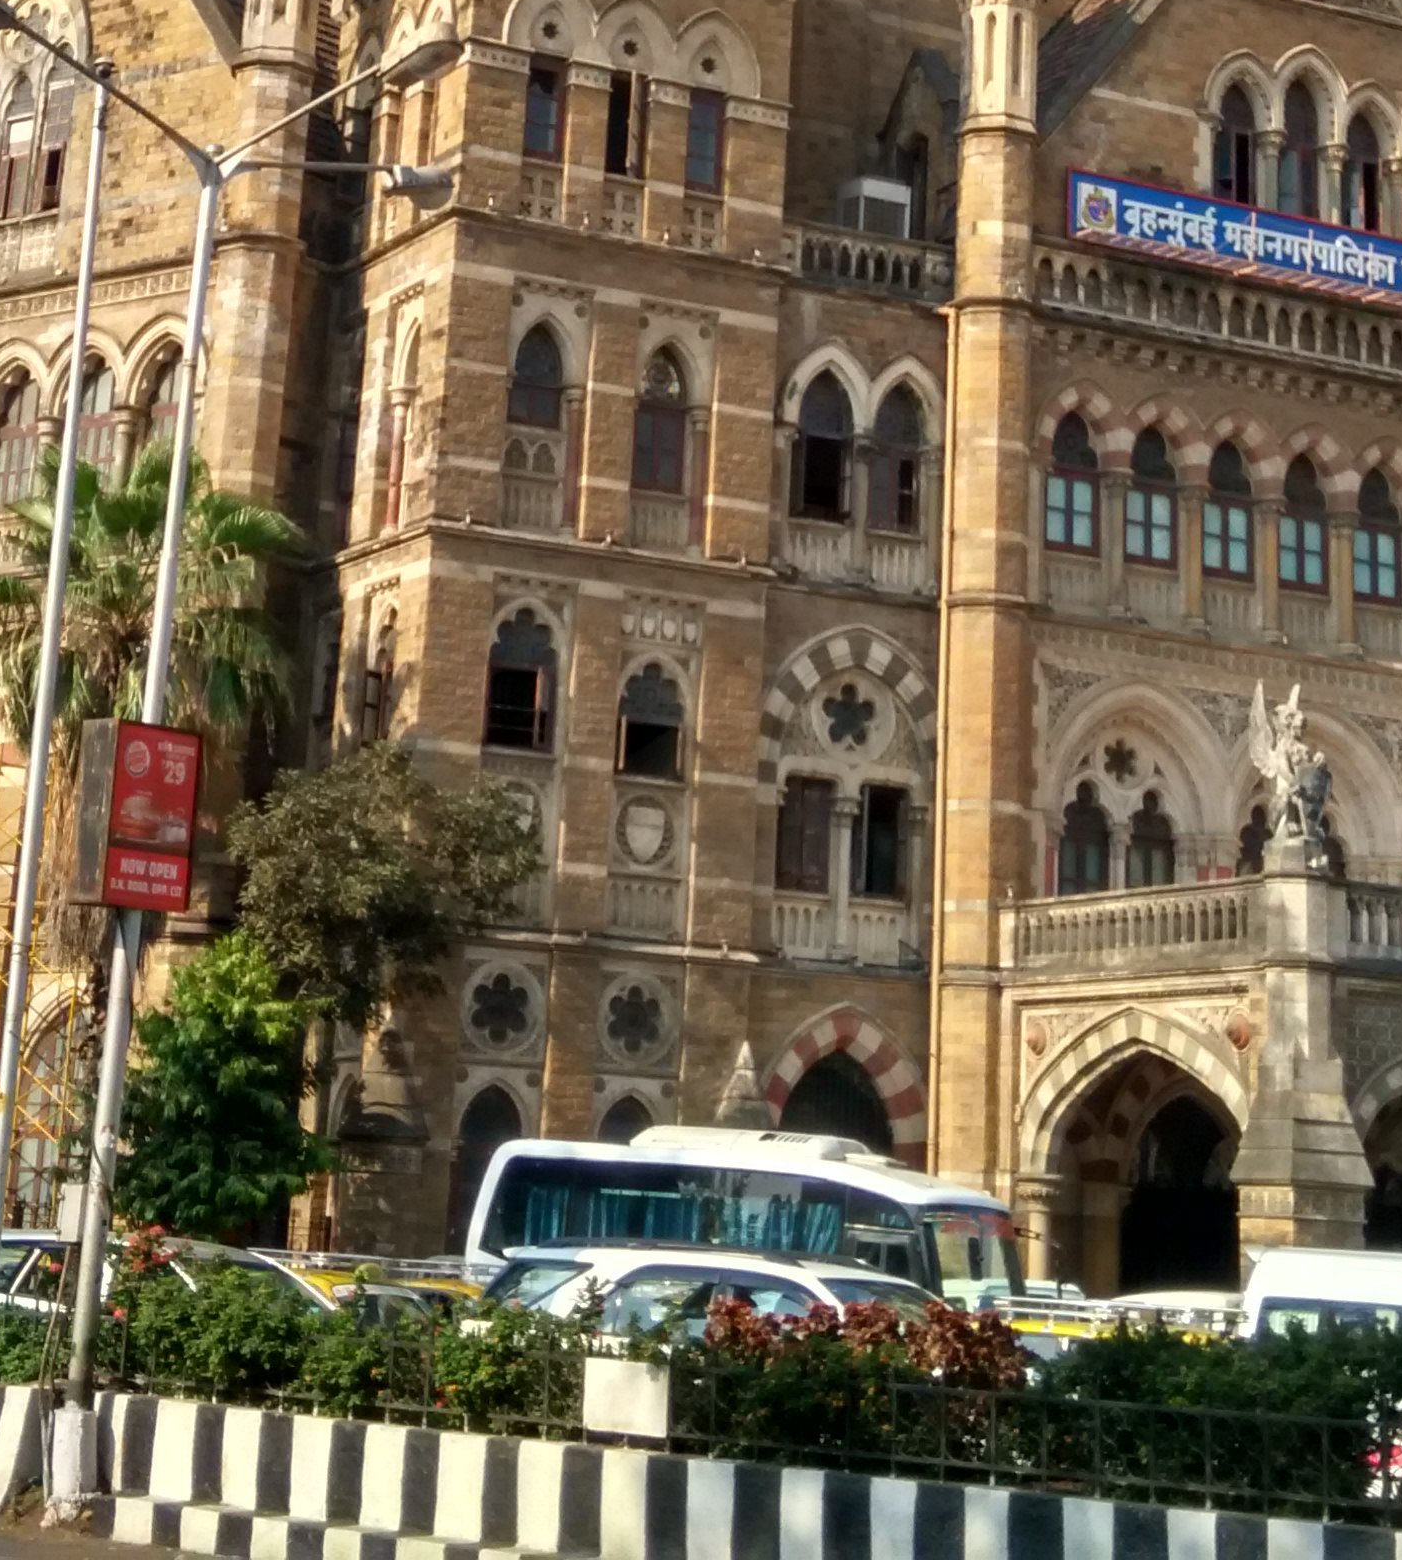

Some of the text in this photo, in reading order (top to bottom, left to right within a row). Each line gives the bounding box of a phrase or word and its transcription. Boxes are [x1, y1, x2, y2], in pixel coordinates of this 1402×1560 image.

[1123, 199, 1217, 252] बृहन्मुंबई
[1223, 220, 1396, 286] महानगरपालिका
[120, 858, 178, 880] NOW OPEN
